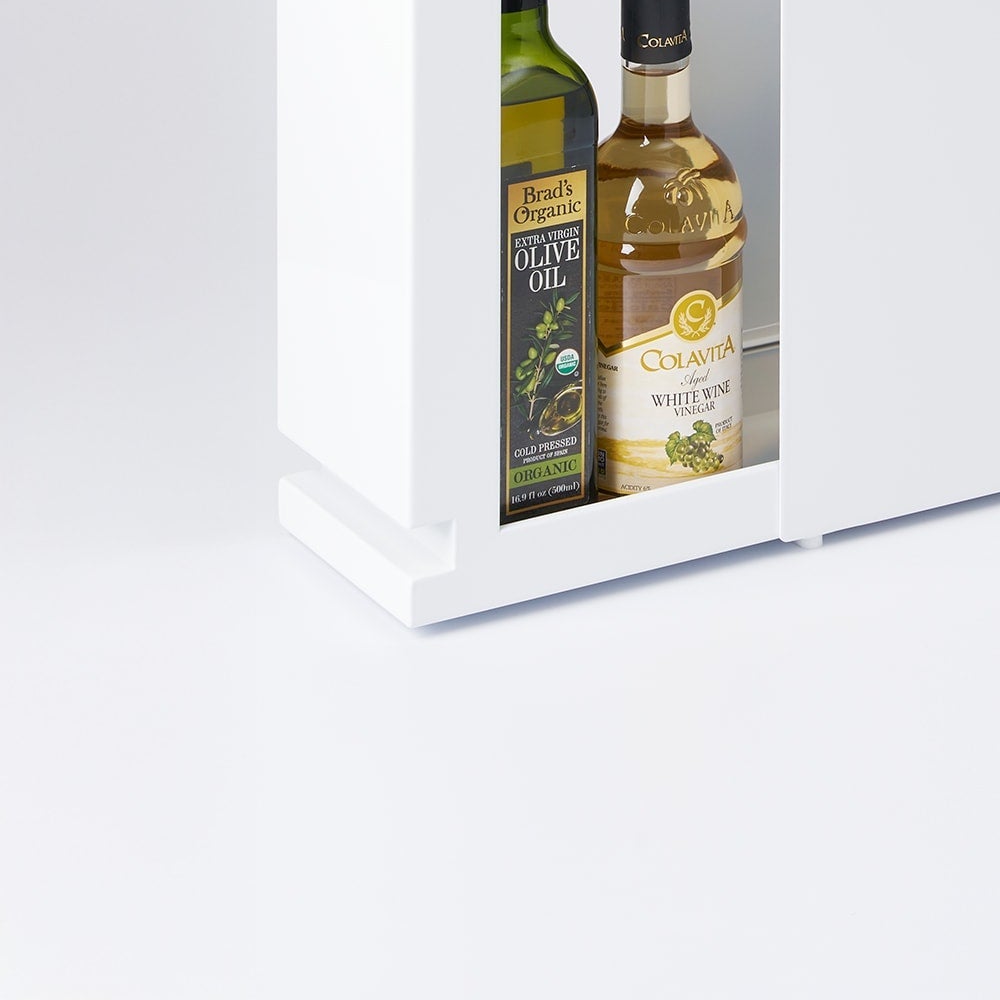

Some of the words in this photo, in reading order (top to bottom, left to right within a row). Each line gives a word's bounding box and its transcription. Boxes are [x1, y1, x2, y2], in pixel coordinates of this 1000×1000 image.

[637, 28, 688, 48] COLAVITA
[522, 179, 573, 205] Brad's
[513, 199, 582, 225] Organic
[625, 199, 734, 234] COLAVITA
[514, 234, 546, 249] EXTRA
[548, 226, 580, 242] VIRGIN
[514, 238, 580, 271] OLIVE
[529, 265, 566, 293] OIL
[640, 334, 735, 372] COLAVITA
[680, 367, 710, 388] Aged
[651, 389, 699, 408] WHITE
[702, 379, 731, 402] WINE
[674, 400, 716, 418] VINEGAR
[514, 443, 538, 459] COLD
[539, 436, 577, 452] PRESSED
[523, 454, 545, 464] PRODUCT
[547, 451, 554, 459] OF
[513, 459, 578, 484] ORGANIC
[511, 493, 527, 505] 16.9
[528, 490, 536, 501] fl
[537, 489, 546, 498] oz
[547, 481, 580, 498] (500ml)
